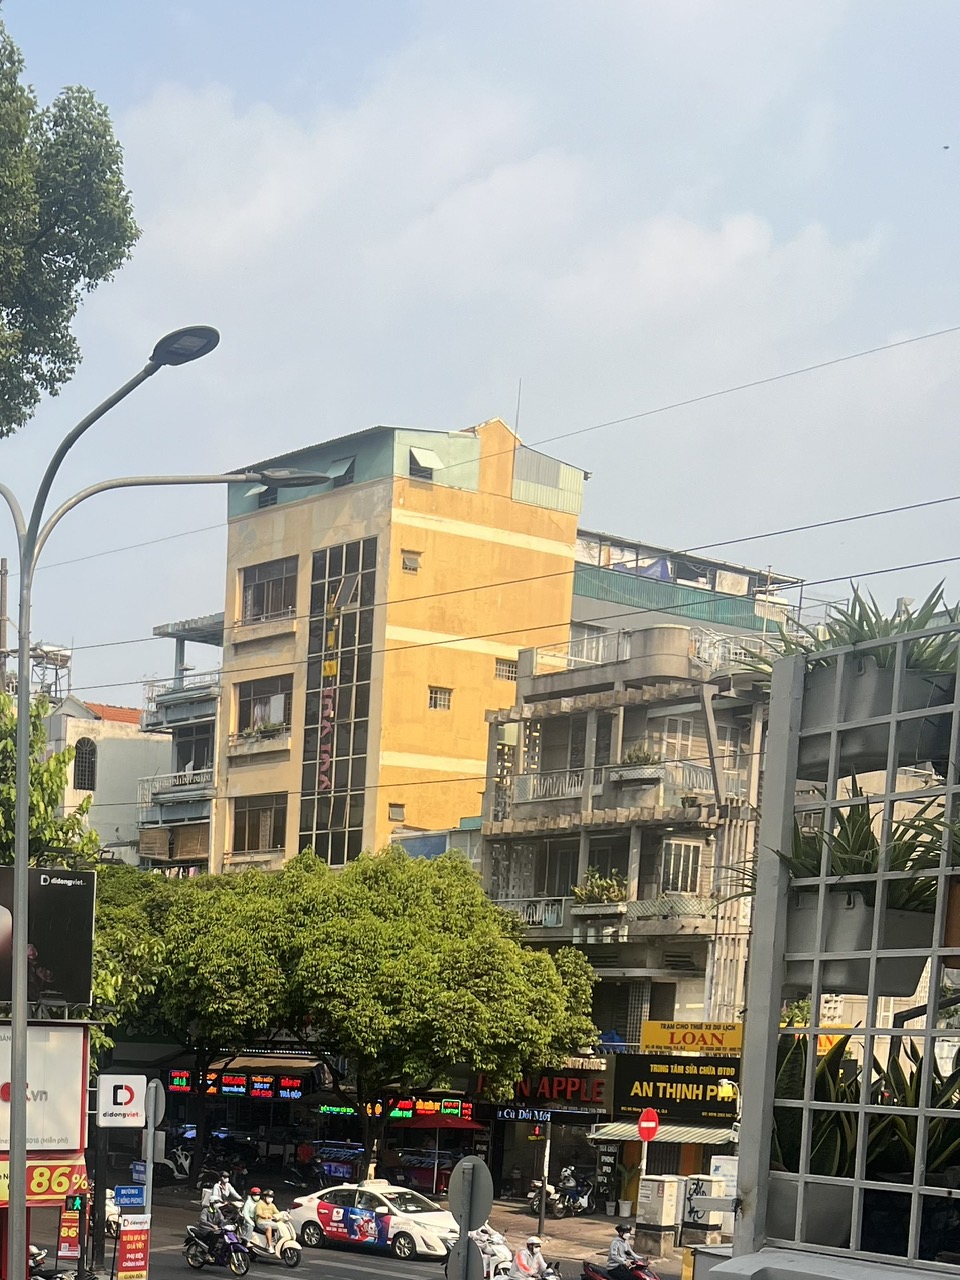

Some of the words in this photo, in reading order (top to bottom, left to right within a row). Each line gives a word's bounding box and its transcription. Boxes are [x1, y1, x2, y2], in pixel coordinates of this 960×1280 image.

[669, 1032, 725, 1045] LOAN
[670, 1064, 684, 1073] TÂM
[536, 1076, 605, 1103] APPLE
[630, 1081, 653, 1097] AN
[657, 1082, 703, 1102] THỊNH
[30, 1167, 88, 1193] 86%
[61, 1227, 79, 1237] 86
